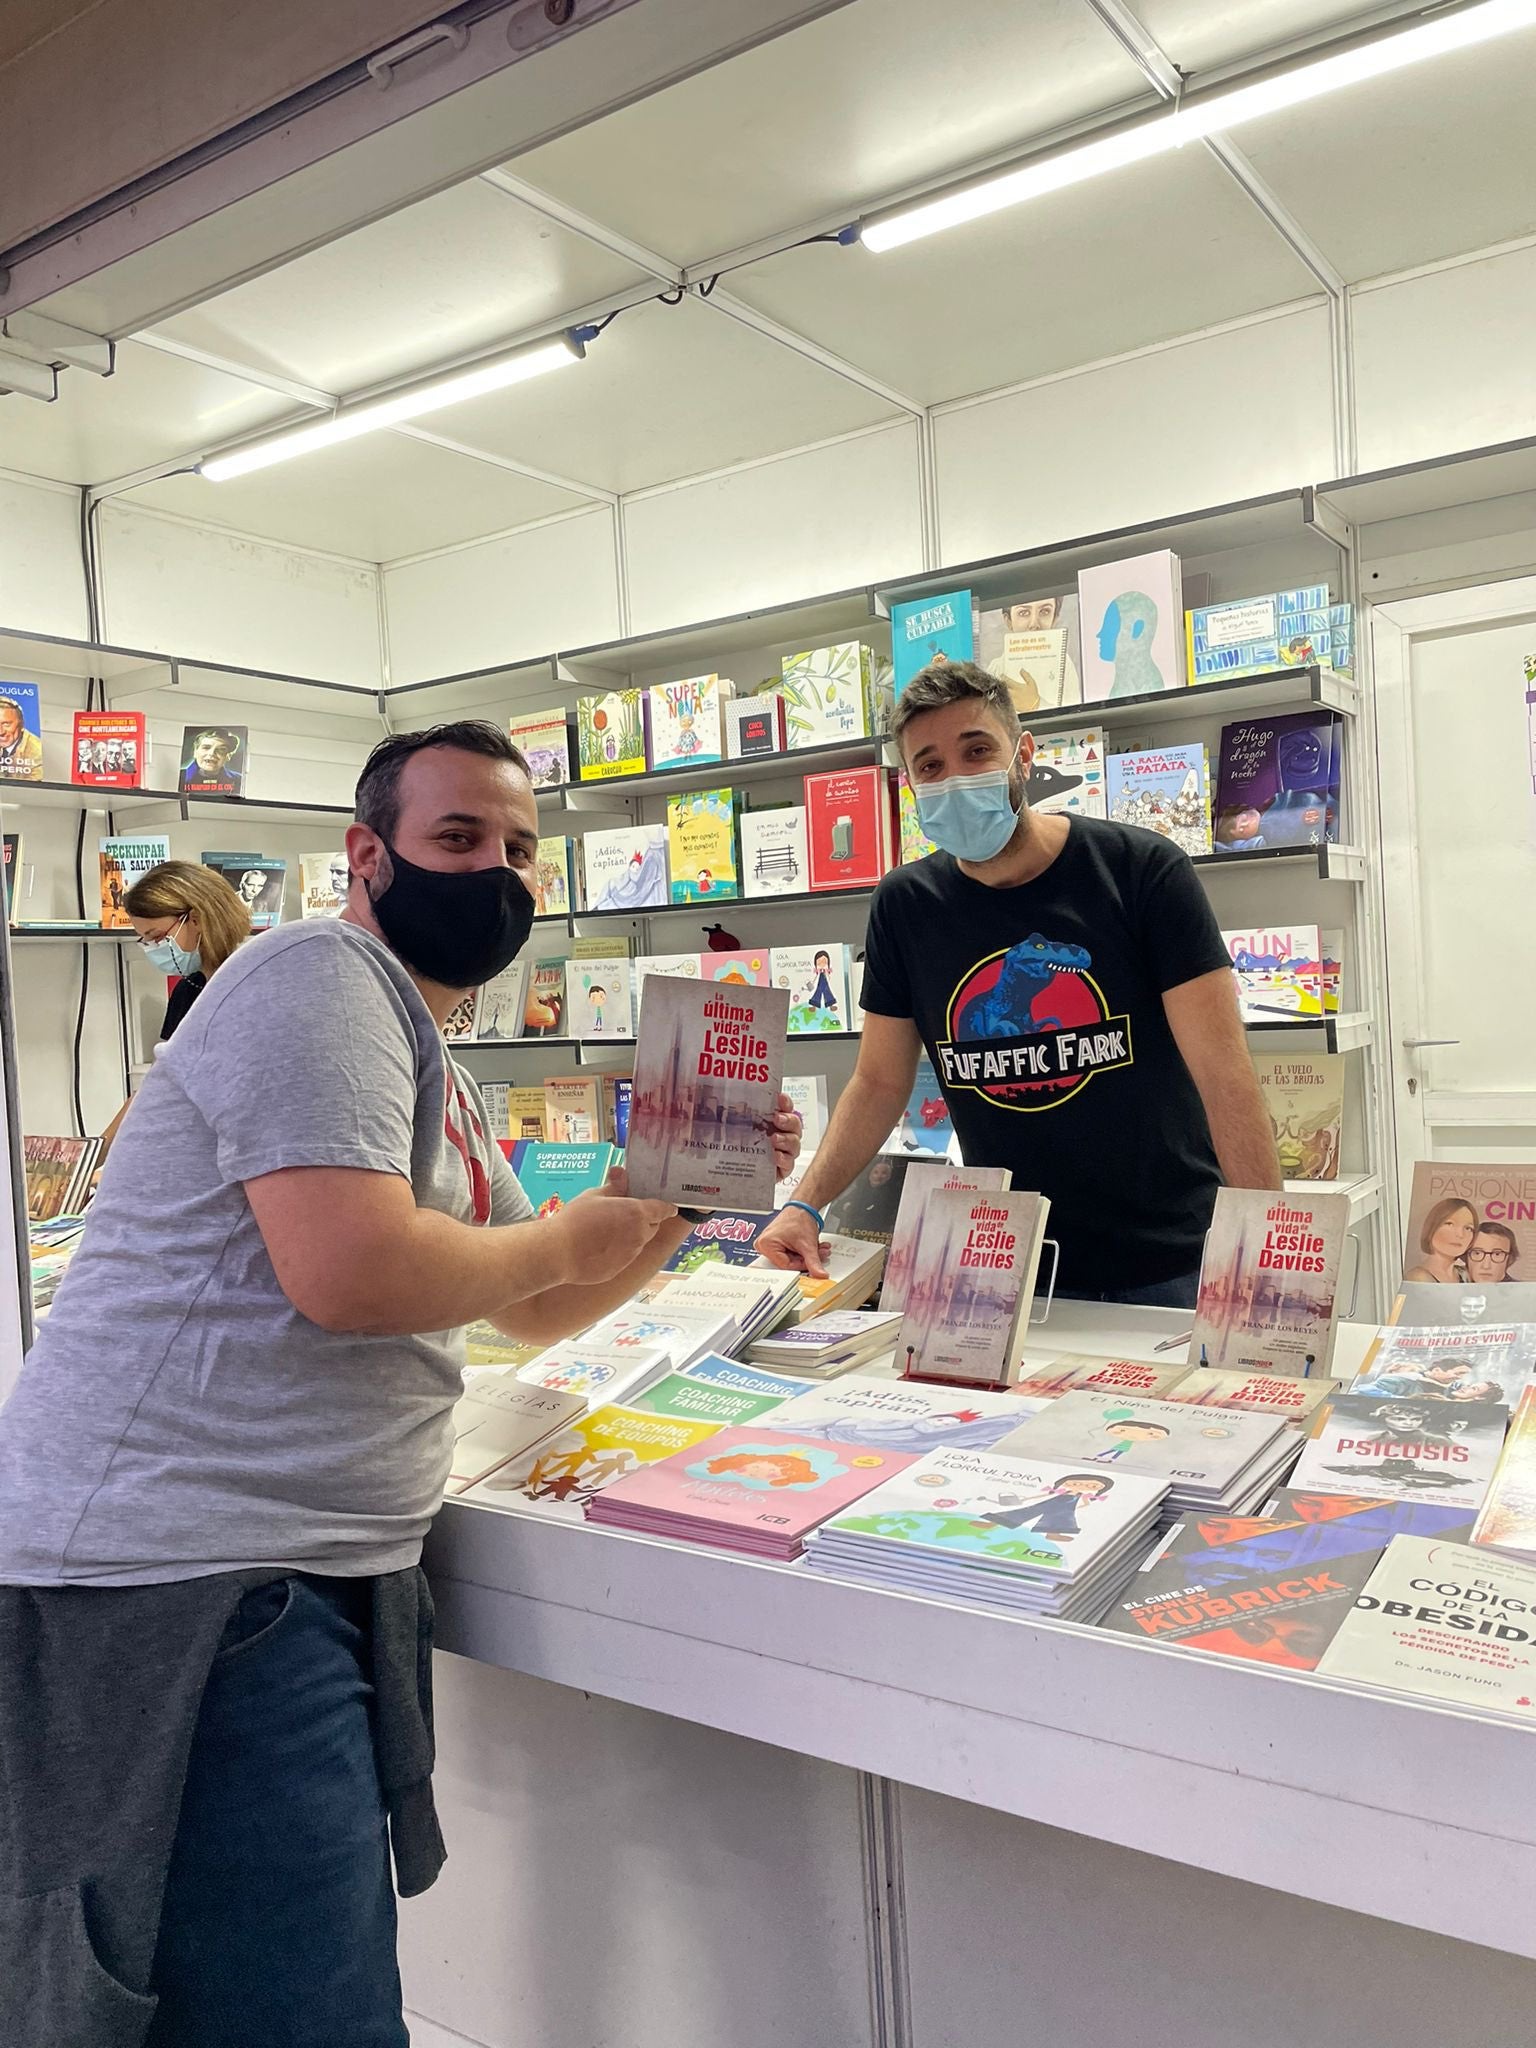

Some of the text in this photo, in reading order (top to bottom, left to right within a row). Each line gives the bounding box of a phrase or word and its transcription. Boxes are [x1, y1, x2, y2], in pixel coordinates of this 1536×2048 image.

[905, 604, 952, 627] SE BUSCA
[906, 618, 956, 640] CULPABLE
[666, 680, 705, 704] SUPER
[668, 698, 703, 719] NONA
[1232, 727, 1273, 747] Hugo
[1121, 755, 1165, 766] LA RATA
[1230, 748, 1266, 764] dragón
[1136, 761, 1187, 774] PATATA
[1231, 767, 1257, 779] noche
[106, 843, 165, 859] PECKINPAH
[595, 846, 624, 858] ¡Adiós,
[106, 860, 126, 872] VIDA
[593, 857, 628, 870] capitán!
[307, 897, 338, 908] Padrino
[715, 992, 724, 1001] La
[703, 1000, 755, 1023] última
[713, 1020, 750, 1036] vida de
[704, 1030, 768, 1060] Leslie
[940, 1031, 1127, 1080] FUFAFFIC FARK
[698, 1052, 770, 1083] Davies
[1274, 1064, 1313, 1075] EL VUELO
[1261, 1074, 1325, 1085] DE LAS BRUJAS
[685, 1140, 707, 1149] FRAN
[722, 1144, 739, 1152] LOS
[740, 1146, 766, 1155] REYES
[536, 1152, 596, 1161] SUPERPODERES
[539, 1160, 590, 1169] CREATIVOS
[1430, 1177, 1536, 1199] PASIONE
[1278, 1200, 1286, 1208] La
[1485, 1200, 1536, 1221] CIN
[970, 1206, 1009, 1221] última
[1266, 1207, 1313, 1224] última
[976, 1221, 996, 1232] vida
[1275, 1223, 1300, 1235] vida
[967, 1229, 1016, 1250] Leslie
[1265, 1231, 1325, 1253] Leslie
[960, 1248, 1015, 1269] Davies
[1258, 1249, 1326, 1273] Davies
[1242, 1320, 1263, 1329] FRAN
[1293, 1326, 1318, 1335] REYES
[1427, 1336, 1461, 1347] BELLO
[1465, 1335, 1478, 1345] ES
[716, 1369, 795, 1396] COACHING
[1086, 1374, 1153, 1388] Davies
[1100, 1369, 1158, 1382] Leslie
[476, 1384, 561, 1411] ELEGÍAS
[677, 1386, 757, 1409] COACHING
[844, 1389, 931, 1406] ¡Adiós,
[1230, 1391, 1304, 1407] Davies
[1240, 1386, 1306, 1400] Leslie
[668, 1396, 743, 1417] FAMILIAR
[823, 1396, 932, 1416] capitán!
[1114, 1398, 1152, 1409] Niño
[1159, 1406, 1185, 1414] del
[1192, 1408, 1247, 1422] Pulgar
[611, 1416, 693, 1439] COACHING
[592, 1424, 688, 1449] DE EQUIPOS
[944, 1453, 981, 1464] LOLA
[1336, 1438, 1470, 1463] PSICOSIS
[1169, 1469, 1208, 1480] ICB
[756, 1513, 790, 1525] ICB
[1022, 1548, 1063, 1560] ICB
[1473, 1579, 1500, 1592] EL
[1122, 1584, 1207, 1611] EL CINE DE
[1130, 1591, 1212, 1619] STANLEY
[1136, 1572, 1348, 1635] KUBRICK
[1442, 1599, 1509, 1621] DE LA
[1392, 1631, 1531, 1665] LOS SECRETOS DE LA
[1417, 1627, 1510, 1652] DESCIFRANDO
[1459, 1653, 1477, 1662] DE
[1480, 1658, 1516, 1670] PESO
[1416, 1666, 1462, 1680] JASON
[1465, 1676, 1503, 1688] FUNG
